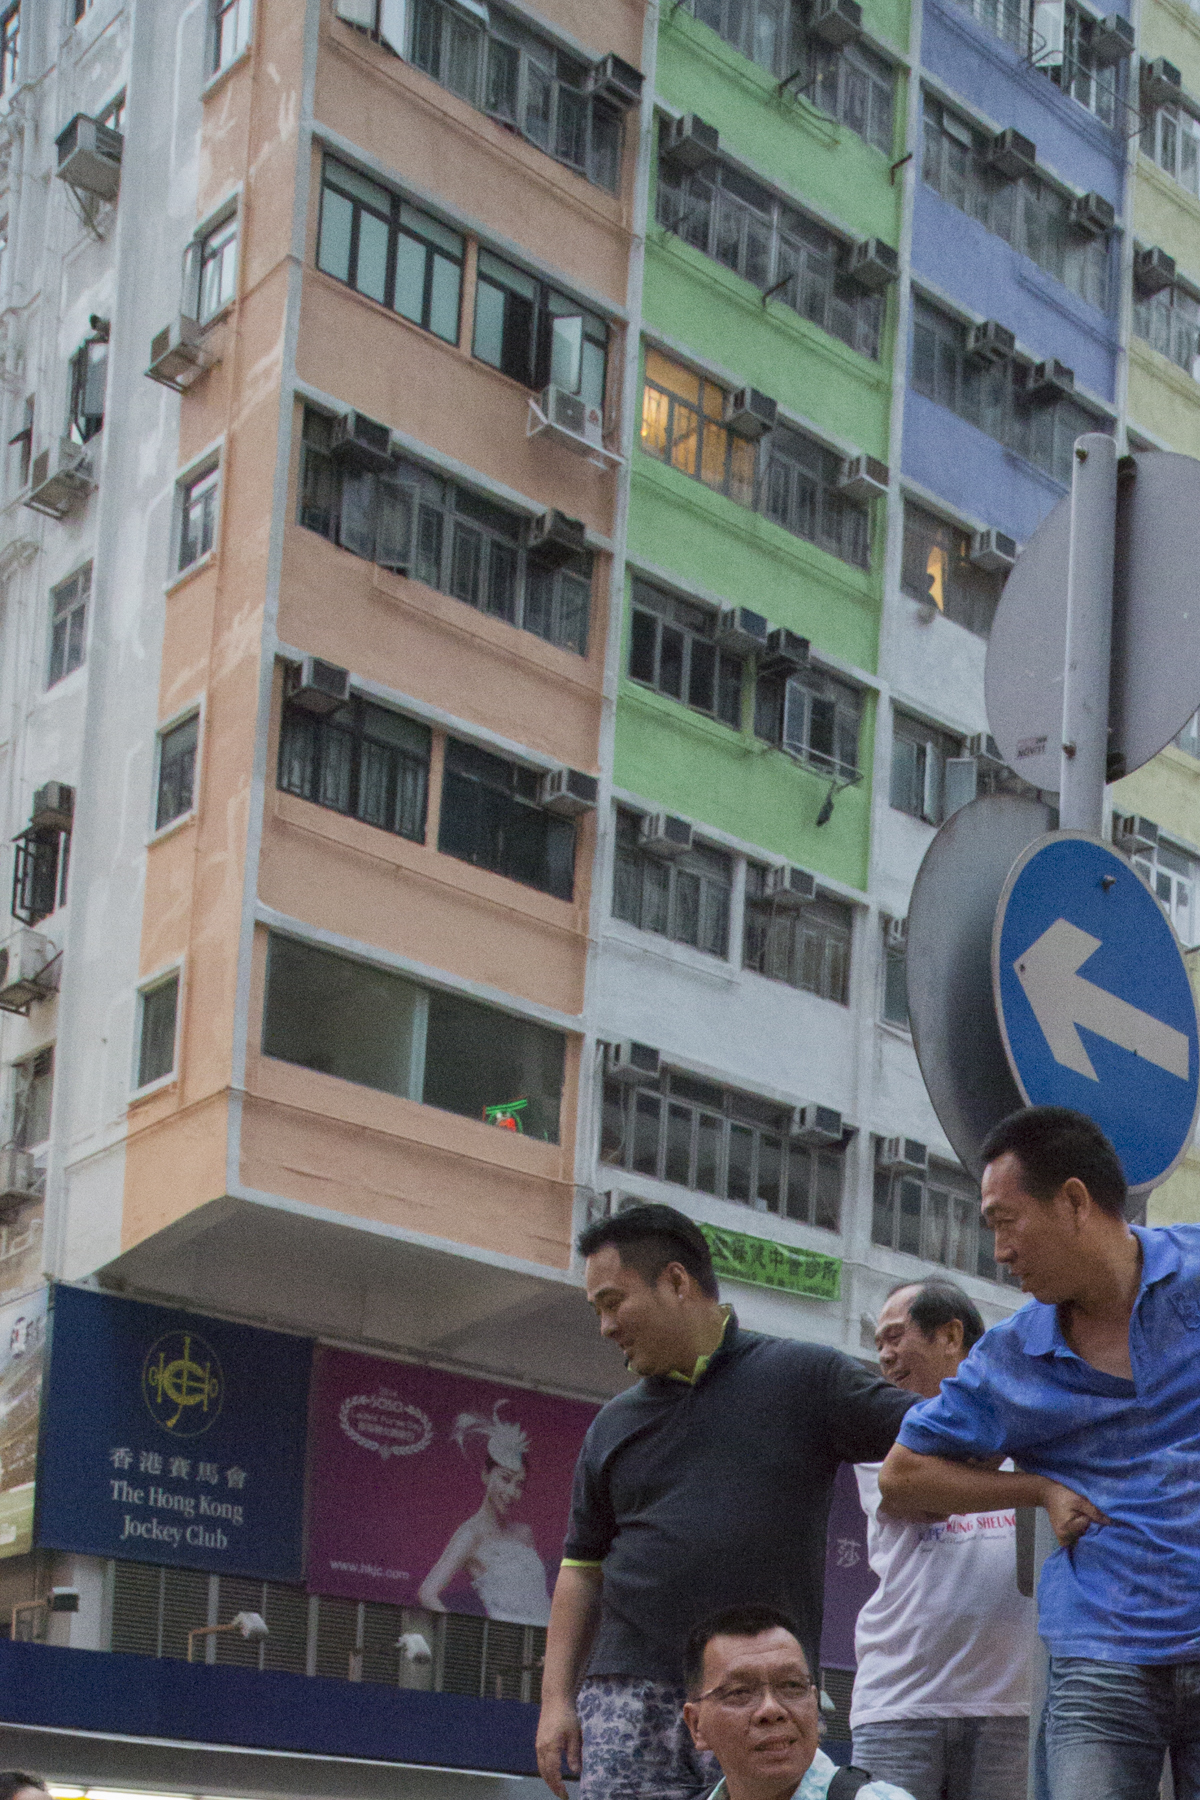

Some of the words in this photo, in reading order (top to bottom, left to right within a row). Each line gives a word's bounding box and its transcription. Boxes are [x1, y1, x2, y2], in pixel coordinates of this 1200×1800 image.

[109, 1447, 247, 1489] 香港賽馬會
[110, 1480, 144, 1504] The
[148, 1486, 195, 1518] Hong
[199, 1494, 243, 1526] Kong
[120, 1514, 182, 1548] Jockey
[186, 1525, 228, 1549] Club
